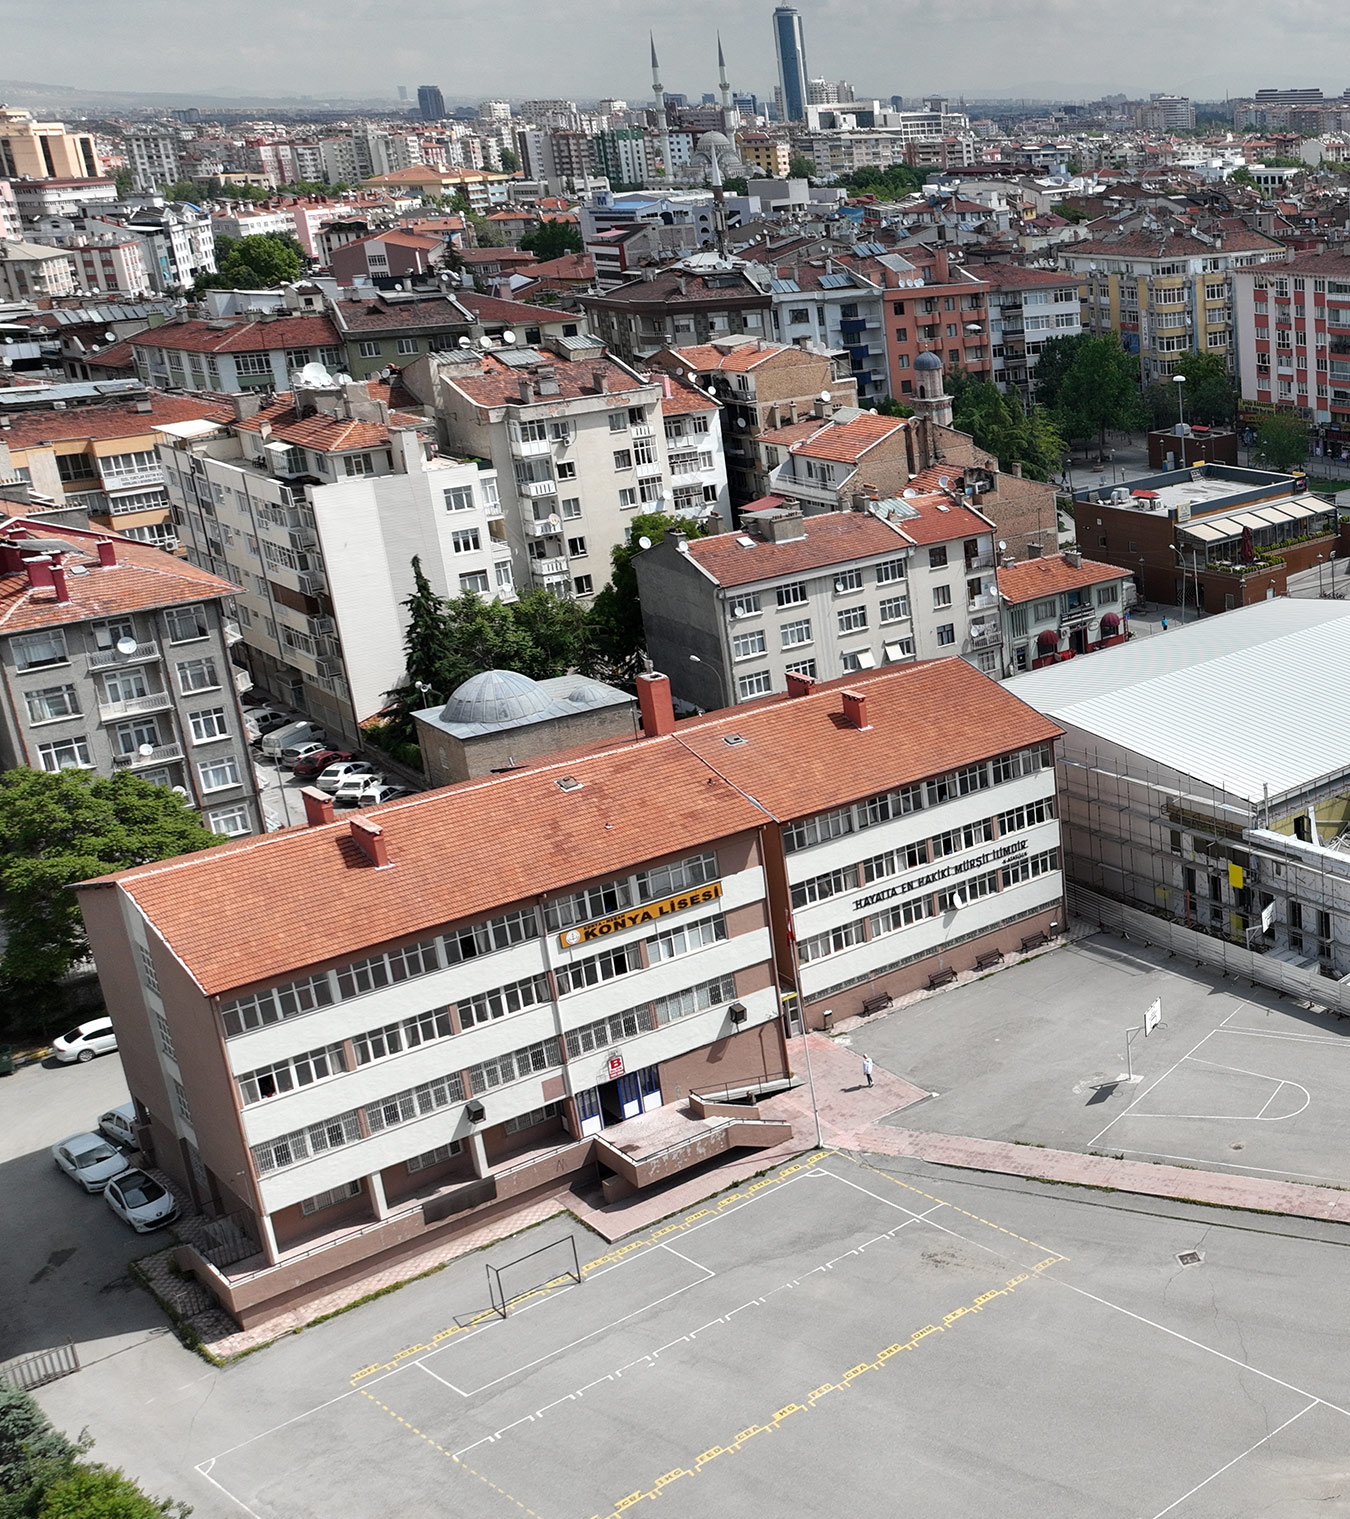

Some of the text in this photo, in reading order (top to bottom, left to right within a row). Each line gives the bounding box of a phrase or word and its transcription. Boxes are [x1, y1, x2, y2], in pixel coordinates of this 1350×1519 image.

[853, 887, 898, 910] HAYATTA
[901, 880, 914, 894] EN
[918, 865, 951, 887] HAKİKİ
[955, 853, 990, 875] MÜRŞİT
[584, 886, 719, 941] KONYA LİSESİ
[610, 1058, 622, 1069] B
